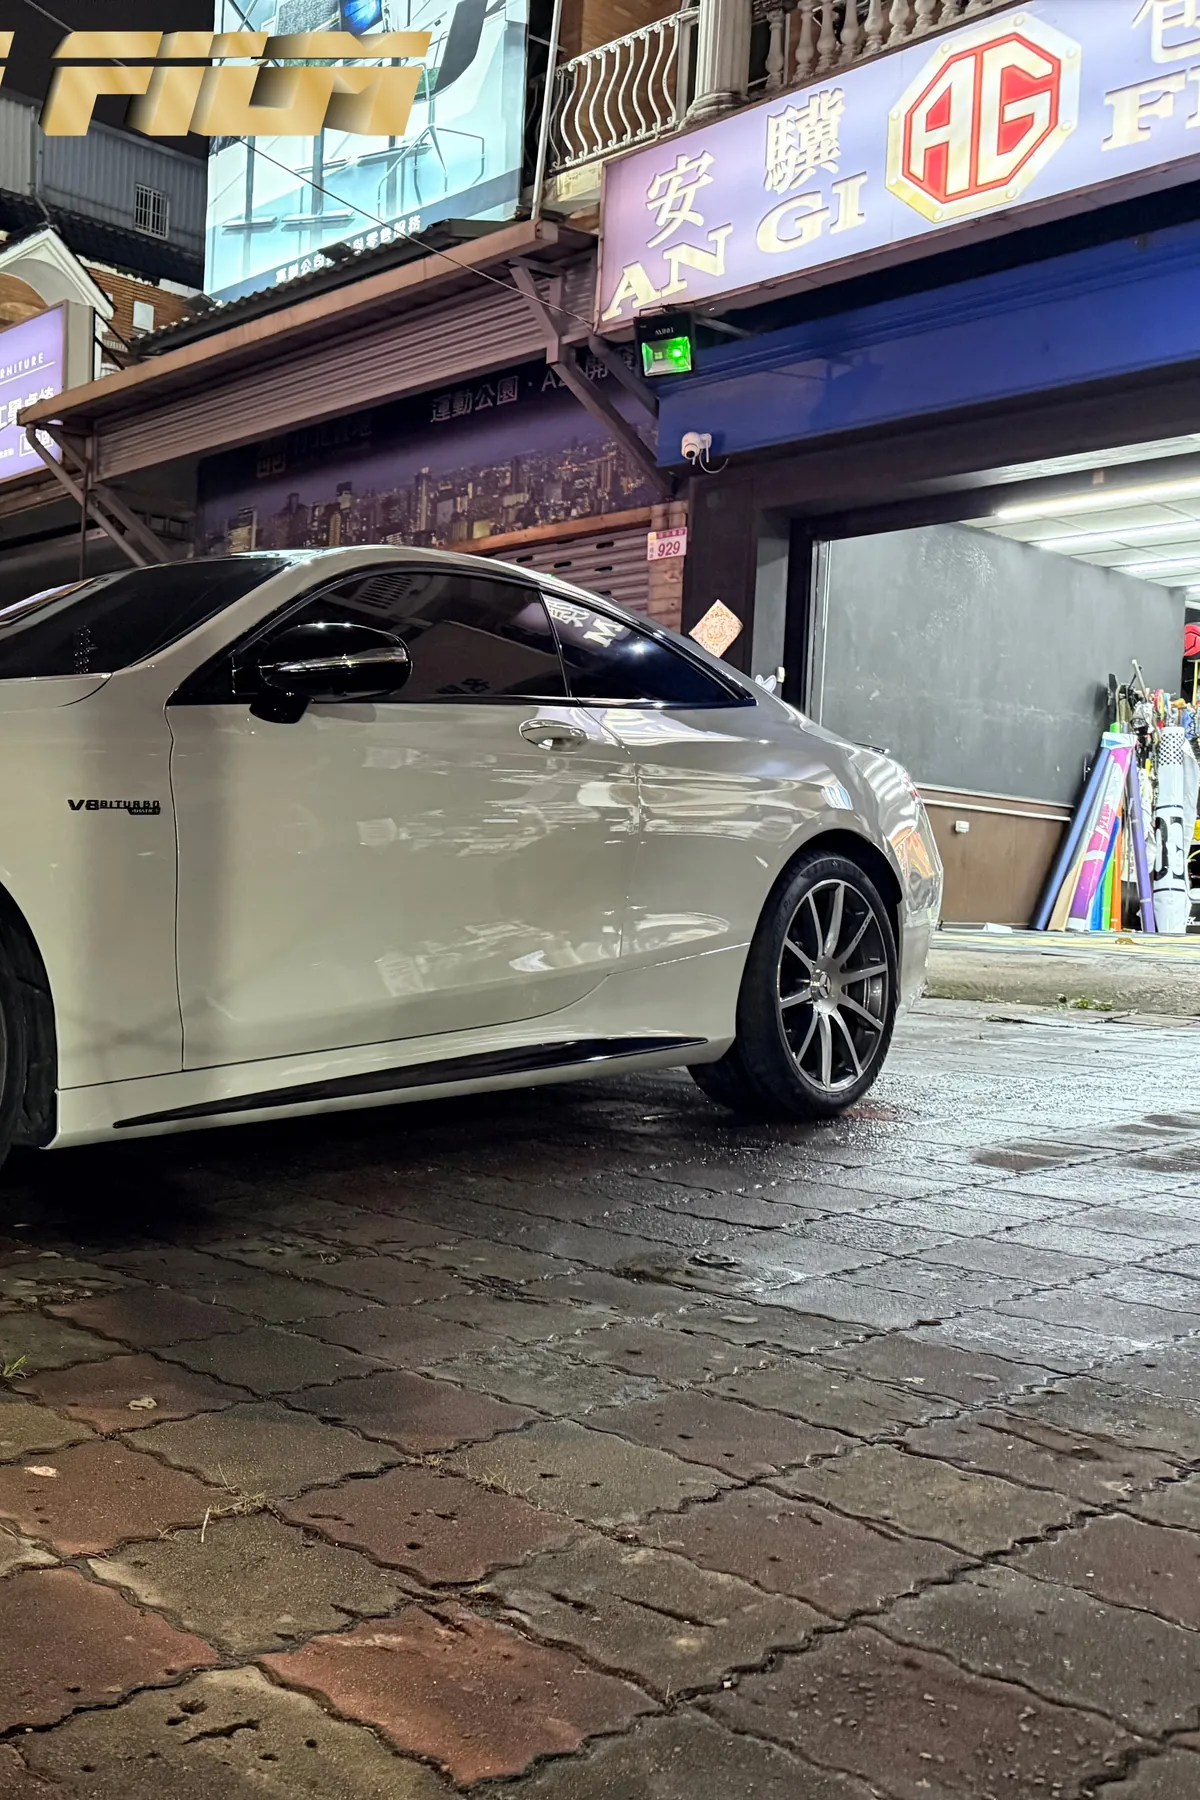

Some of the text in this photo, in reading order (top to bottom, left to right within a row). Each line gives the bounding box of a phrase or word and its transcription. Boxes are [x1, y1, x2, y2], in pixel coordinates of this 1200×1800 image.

[602, 172, 867, 321] AN GI
[430, 375, 519, 424] 運動公園
[657, 540, 681, 557] 929
[67, 799, 99, 811] V8
